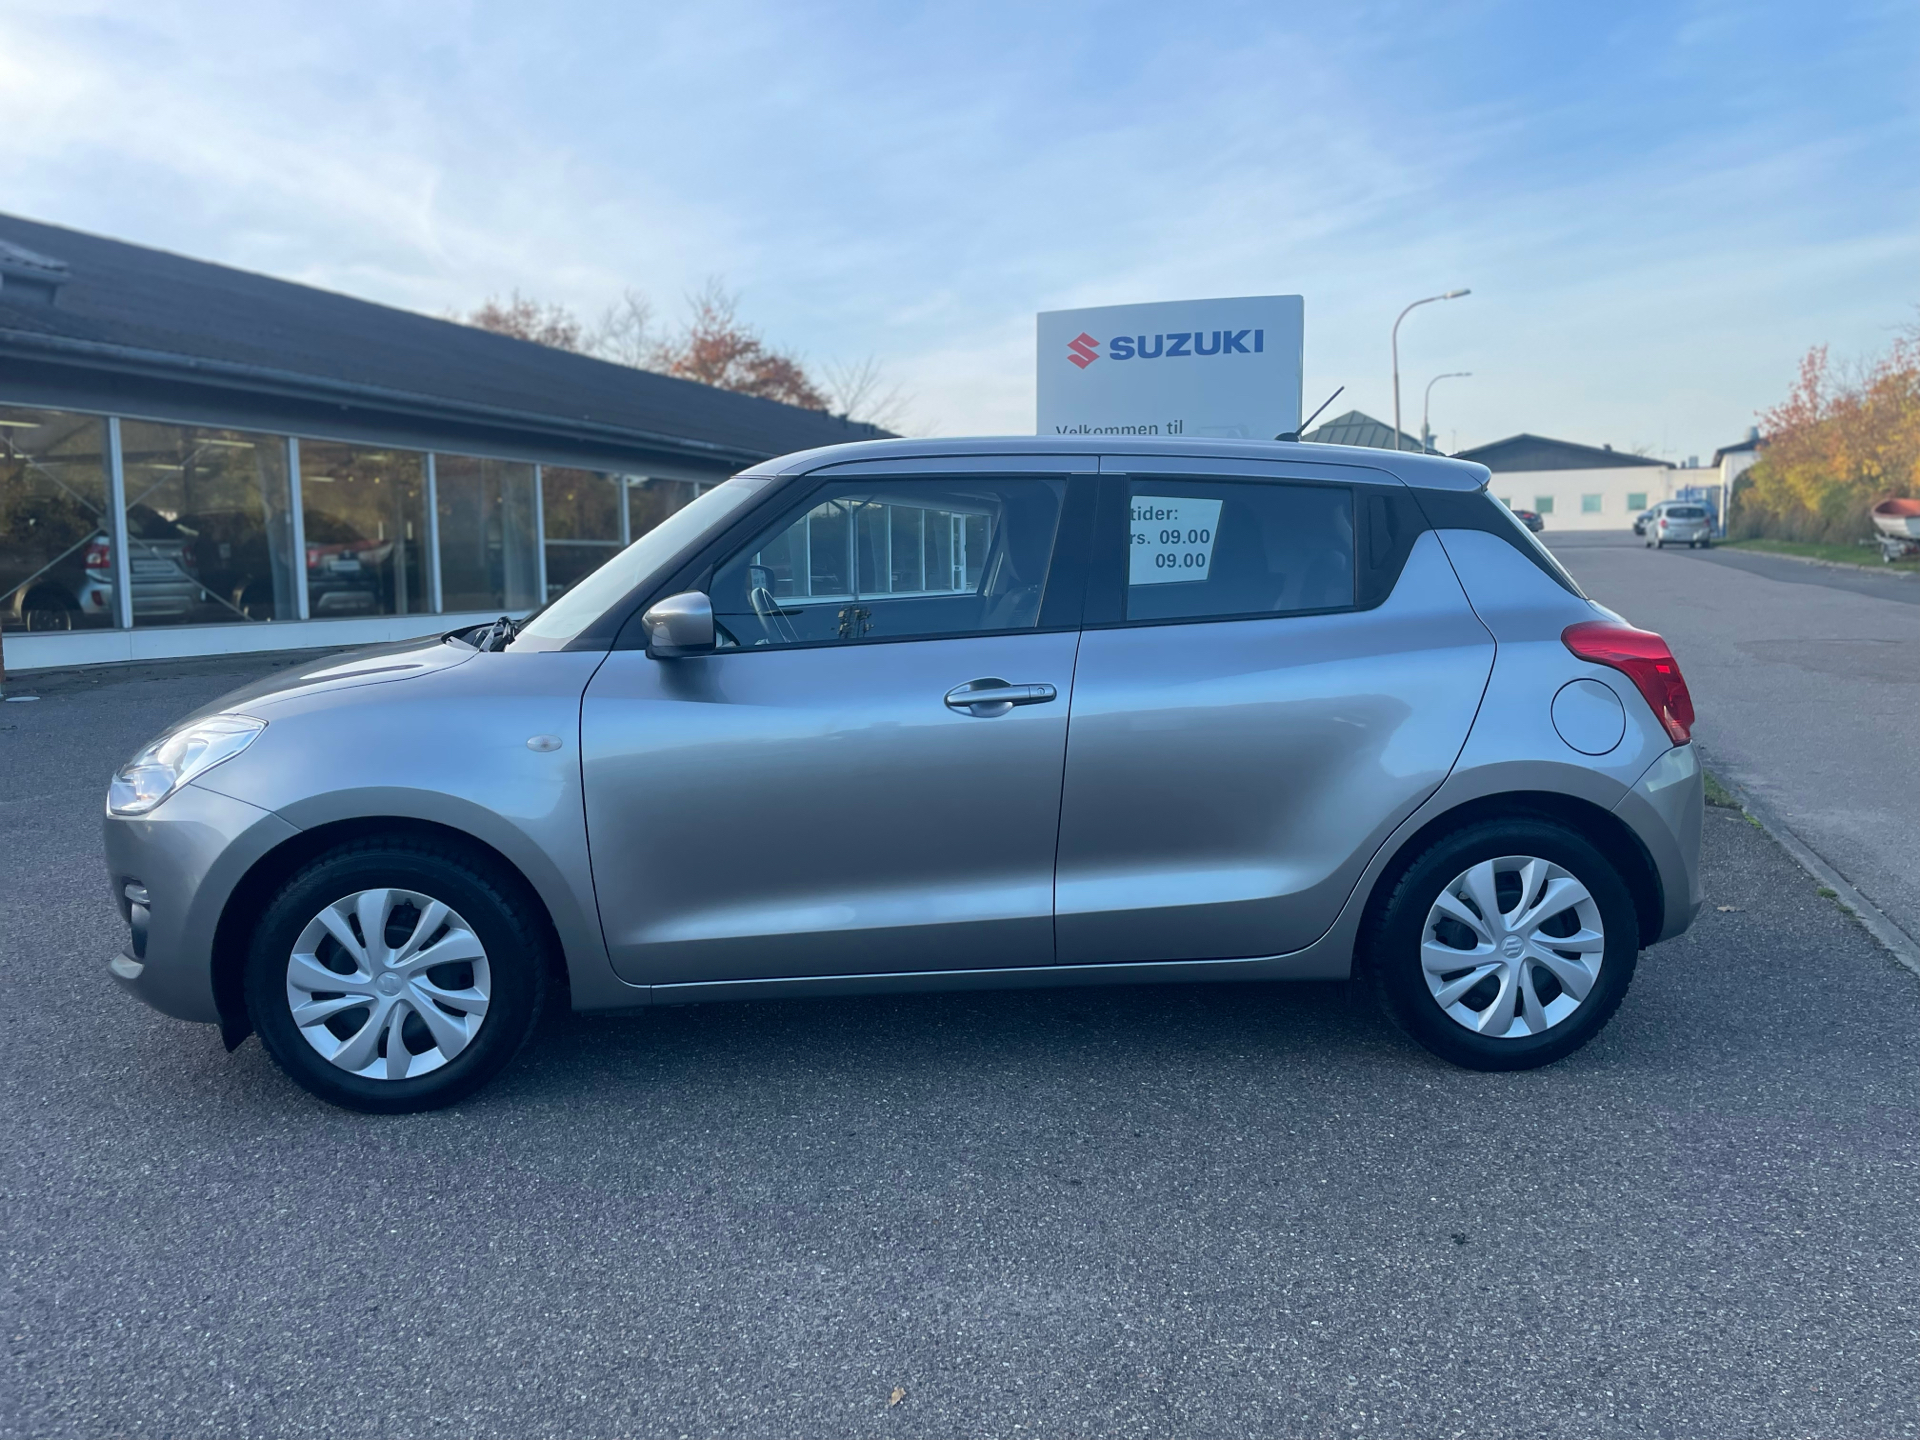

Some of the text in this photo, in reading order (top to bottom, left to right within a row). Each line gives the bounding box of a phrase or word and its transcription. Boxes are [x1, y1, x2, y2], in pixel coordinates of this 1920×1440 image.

[1109, 329, 1264, 361] SUZUKI
[1166, 419, 1183, 435] til
[1160, 529, 1210, 545] 09.00
[1155, 553, 1206, 568] 09.00
